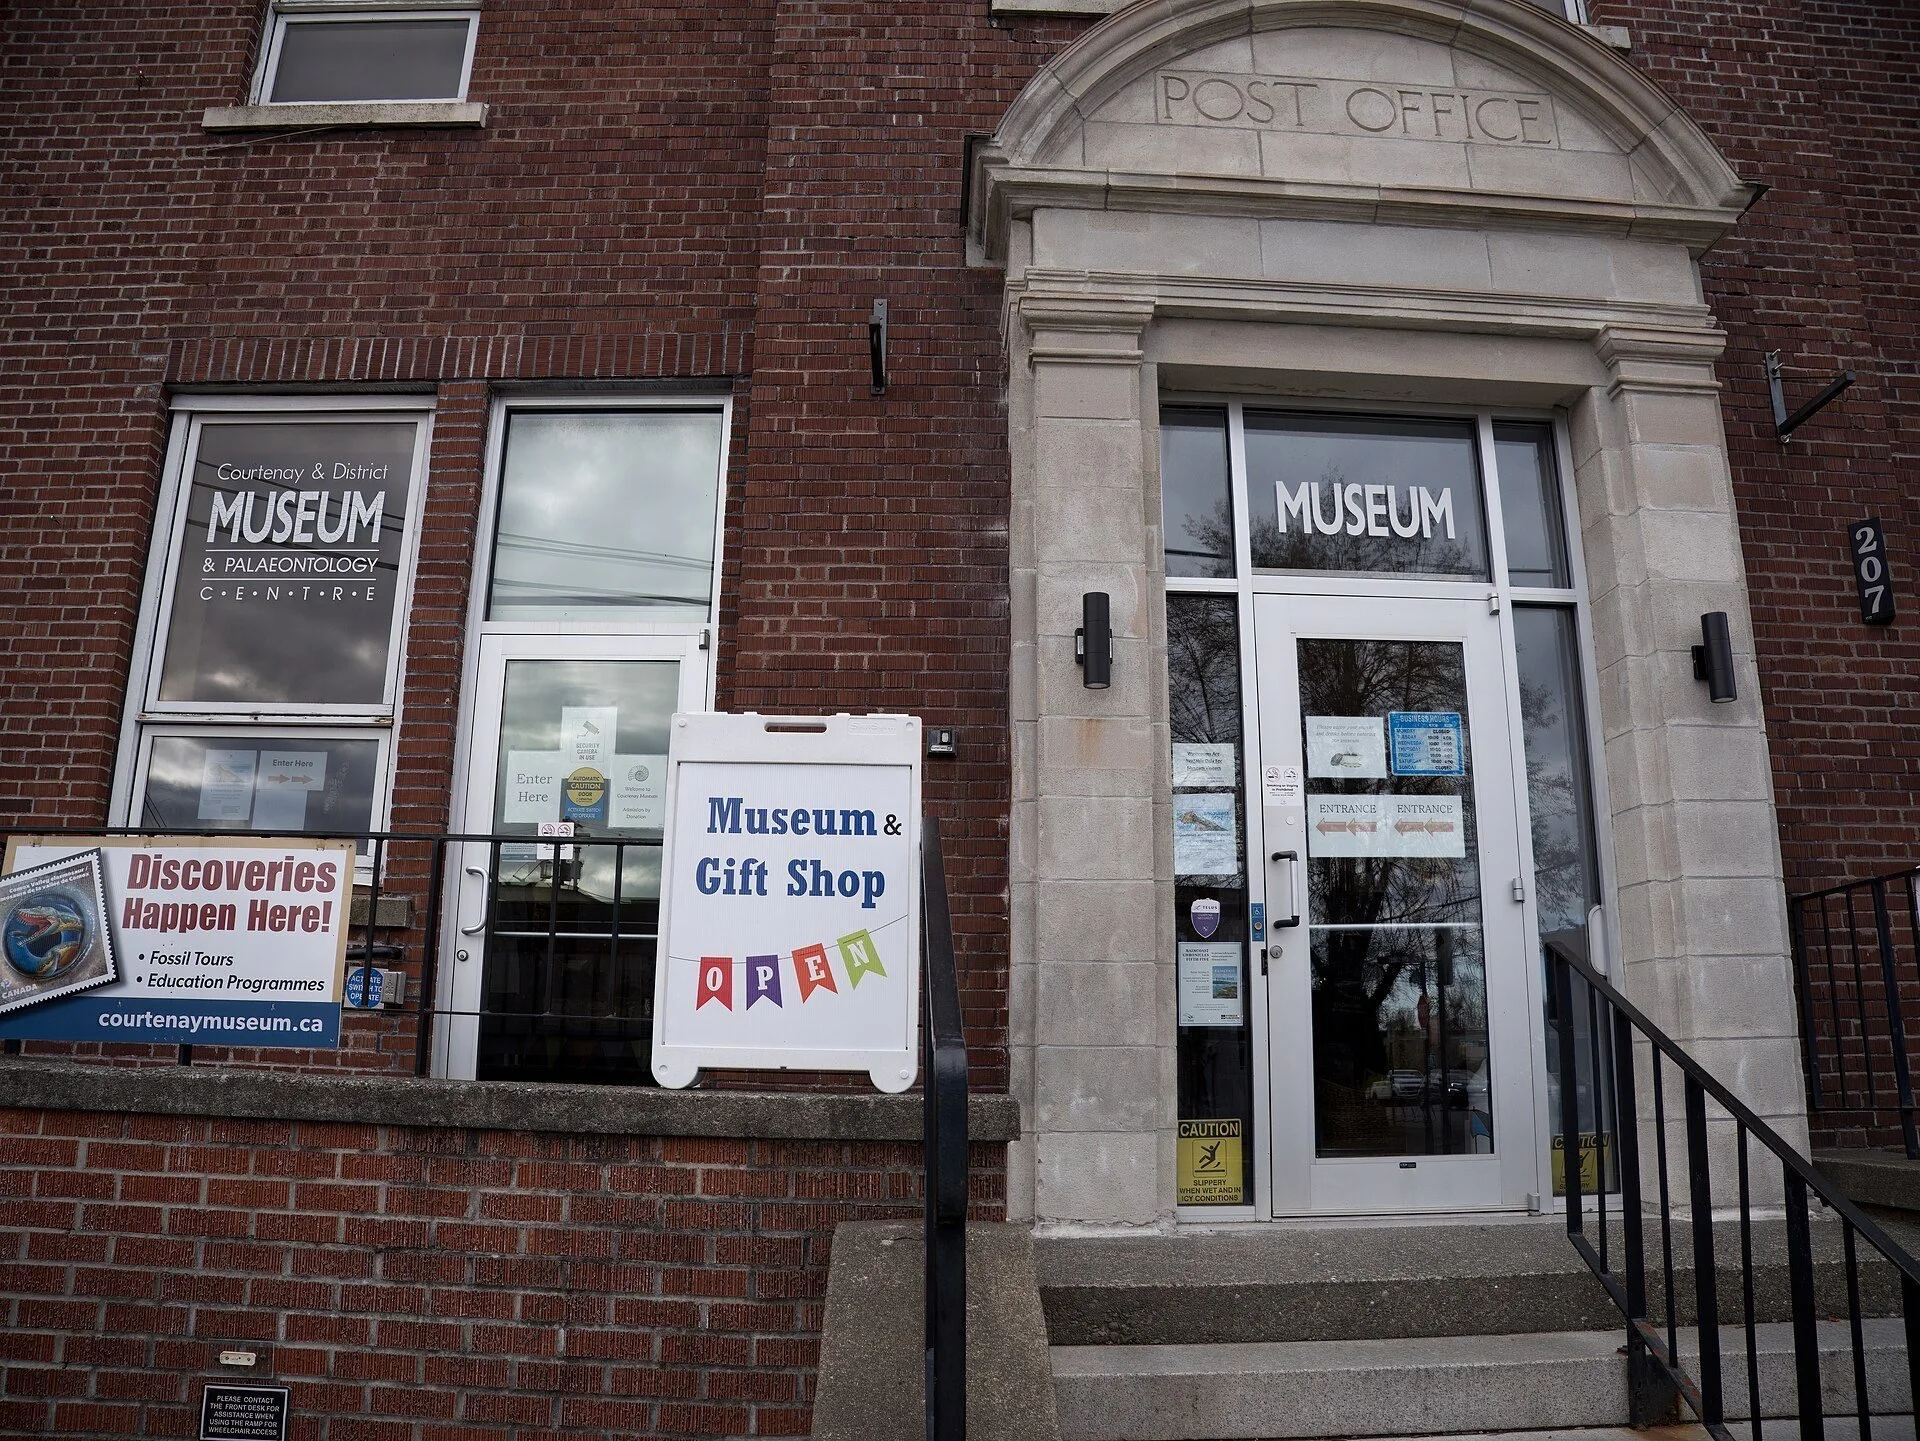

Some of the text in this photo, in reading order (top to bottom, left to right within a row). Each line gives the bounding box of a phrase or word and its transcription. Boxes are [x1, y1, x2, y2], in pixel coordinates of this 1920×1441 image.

[1161, 75, 1551, 144] POST OFFICE
[217, 462, 388, 483] Courtenay & District
[206, 490, 386, 543] MUSEUM
[1276, 480, 1455, 539] MUSEUM
[203, 557, 379, 573] & PALAEONTOLOGY
[1856, 527, 1884, 614] 207
[1400, 715, 1450, 723] BUSINESS HOURS
[273, 759, 293, 767] Enter
[517, 773, 552, 784] Enter
[518, 791, 549, 802] Here
[707, 797, 902, 836] Museum &
[1319, 805, 1454, 814] ENTRANCE ENTRANCE
[69, 872, 90, 881] Comox
[127, 854, 337, 893] Discoveries
[9, 885, 30, 893] Comox
[31, 878, 50, 887] Valley
[696, 857, 885, 909] Gift Shop
[122, 898, 333, 933] Happen Here!
[150, 951, 234, 966] Fossil Tours
[707, 942, 869, 991] OPEN
[148, 973, 325, 993] Education Programmes
[351, 975, 381, 984] ACTATE
[2, 984, 38, 999] CANADA
[348, 984, 373, 992] SWITH
[350, 993, 380, 1001] OPEATE
[98, 1011, 323, 1033] courtenaymuseum.ca
[1180, 1123, 1238, 1136] CAUTION
[1554, 1134, 1610, 1149] CTION
[243, 1396, 274, 1404] CONTACT
[214, 1411, 253, 1419] ASSISTANCE
[251, 1428, 277, 1436] ACCESS
